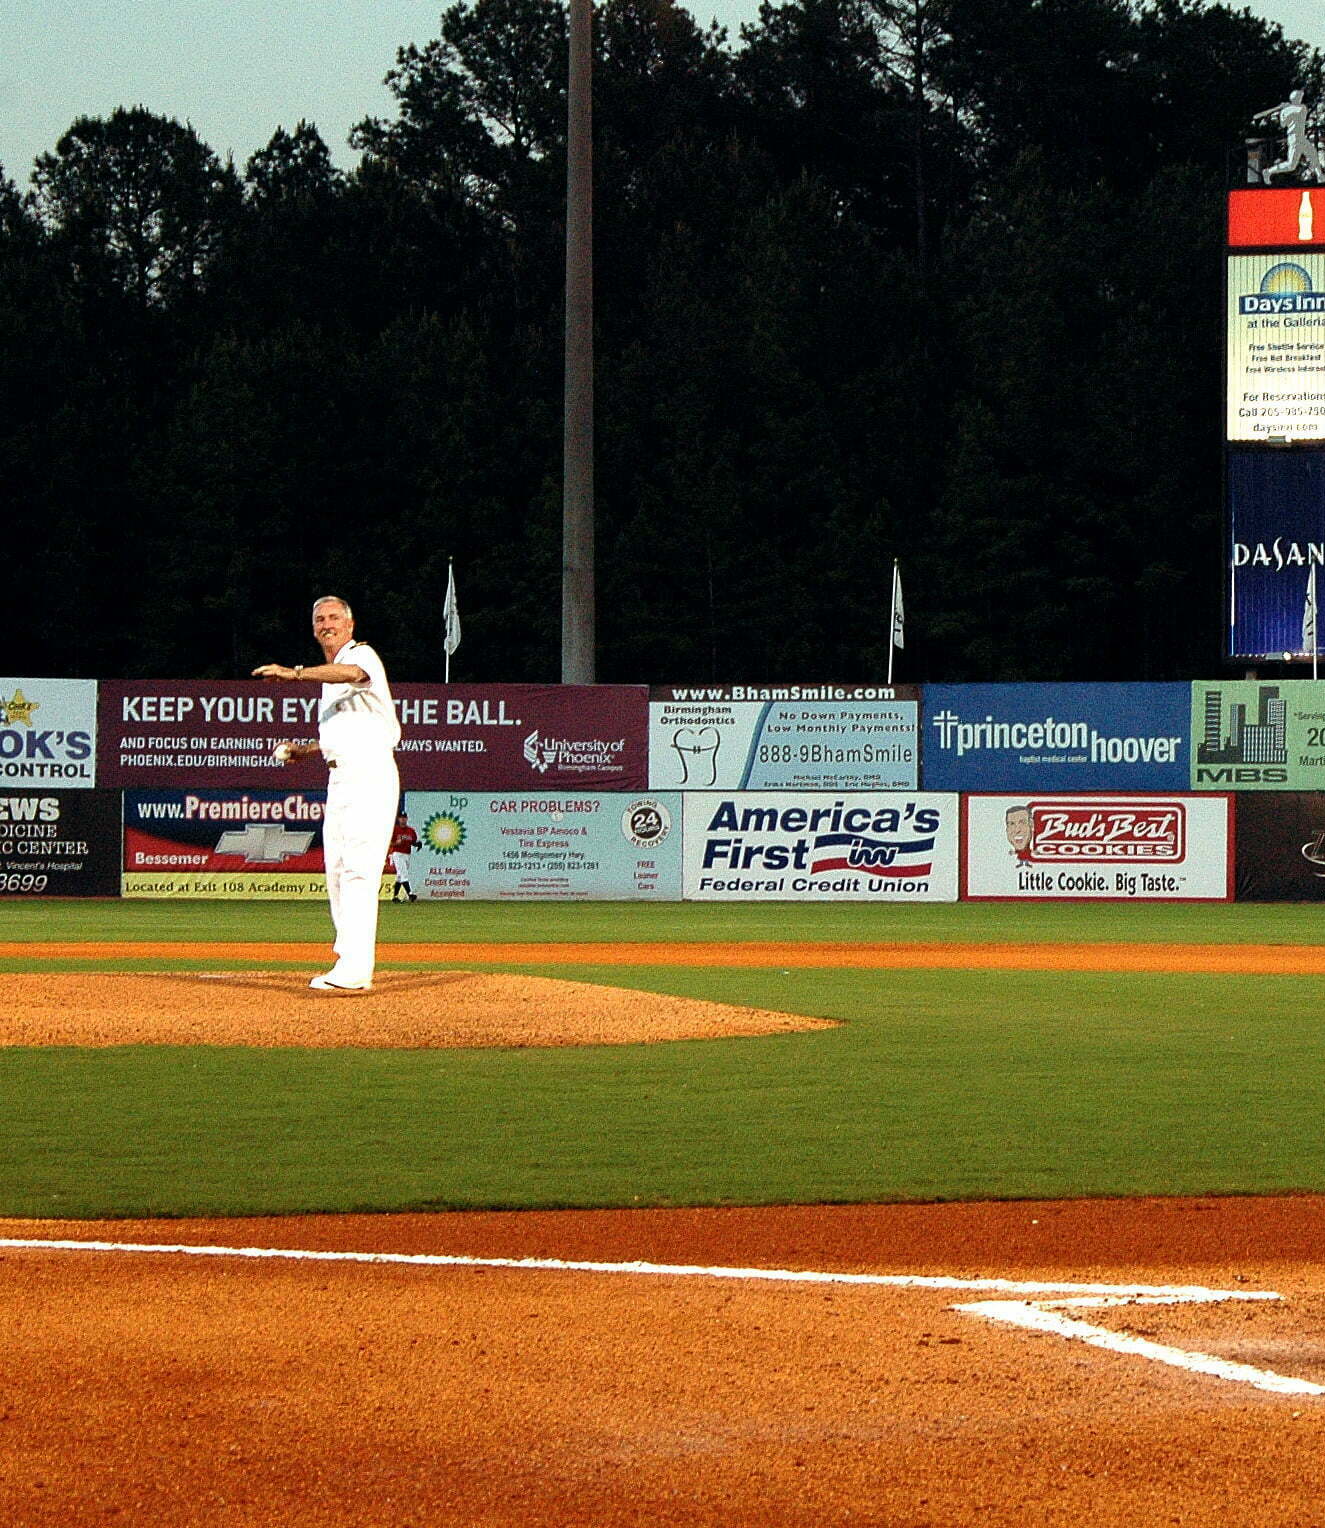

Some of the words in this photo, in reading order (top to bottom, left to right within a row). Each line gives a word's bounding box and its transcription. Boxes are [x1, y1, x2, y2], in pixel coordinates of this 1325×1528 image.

[1244, 296, 1292, 312] Days
[1247, 318, 1258, 328] at
[1261, 318, 1280, 327] the
[1243, 392, 1259, 401] For
[672, 685, 895, 701] www.BhamSmile.com
[122, 696, 194, 722] KEEP
[200, 696, 274, 723] YOUR
[282, 697, 322, 723] EY
[446, 699, 522, 726] BALL.
[663, 705, 732, 717] Birmingham
[779, 712, 796, 721] No
[801, 712, 835, 721] Down
[840, 712, 904, 722] Payments,
[660, 716, 735, 726] Orthodontics
[767, 725, 792, 733] Low
[796, 724, 847, 734] Monthly
[852, 724, 915, 734] Payments!
[119, 737, 145, 750] AND
[148, 737, 187, 750] FOCUS
[190, 737, 207, 750] ON
[210, 738, 263, 750] EARNING
[435, 739, 487, 753] WANTED.
[544, 738, 610, 754] University
[610, 738, 625, 752] of
[957, 716, 1088, 756] princeton
[1091, 730, 1181, 763] hoover
[120, 754, 285, 767] PHOENIX.EDU/BIRMINGHAM
[559, 751, 611, 764] Phoenix
[759, 744, 912, 763] 888-9BhamSmile
[0, 762, 91, 779] ONTROL
[1197, 768, 1288, 783] MBS
[450, 794, 469, 811] bp
[490, 800, 517, 813] CAR
[520, 800, 600, 813] PROBLEMS?
[633, 811, 659, 828] 24
[706, 801, 941, 833] America's
[1103, 814, 1177, 843] Best
[17, 841, 89, 855] CENTER
[701, 838, 811, 870] First
[1036, 843, 1175, 856] COOKIES
[135, 851, 209, 865] Bessemer
[126, 882, 174, 893] Located
[178, 882, 189, 893] at
[194, 882, 217, 893] Exit
[222, 881, 244, 893] 108
[249, 882, 305, 895] Academy
[699, 878, 785, 892] Federal
[791, 878, 861, 892] Credit
[867, 878, 930, 892] Union
[1018, 872, 1053, 891] Little
[1057, 872, 1110, 892] Cookie.
[1115, 872, 1138, 896] Big
[1141, 872, 1180, 892] Taste.
